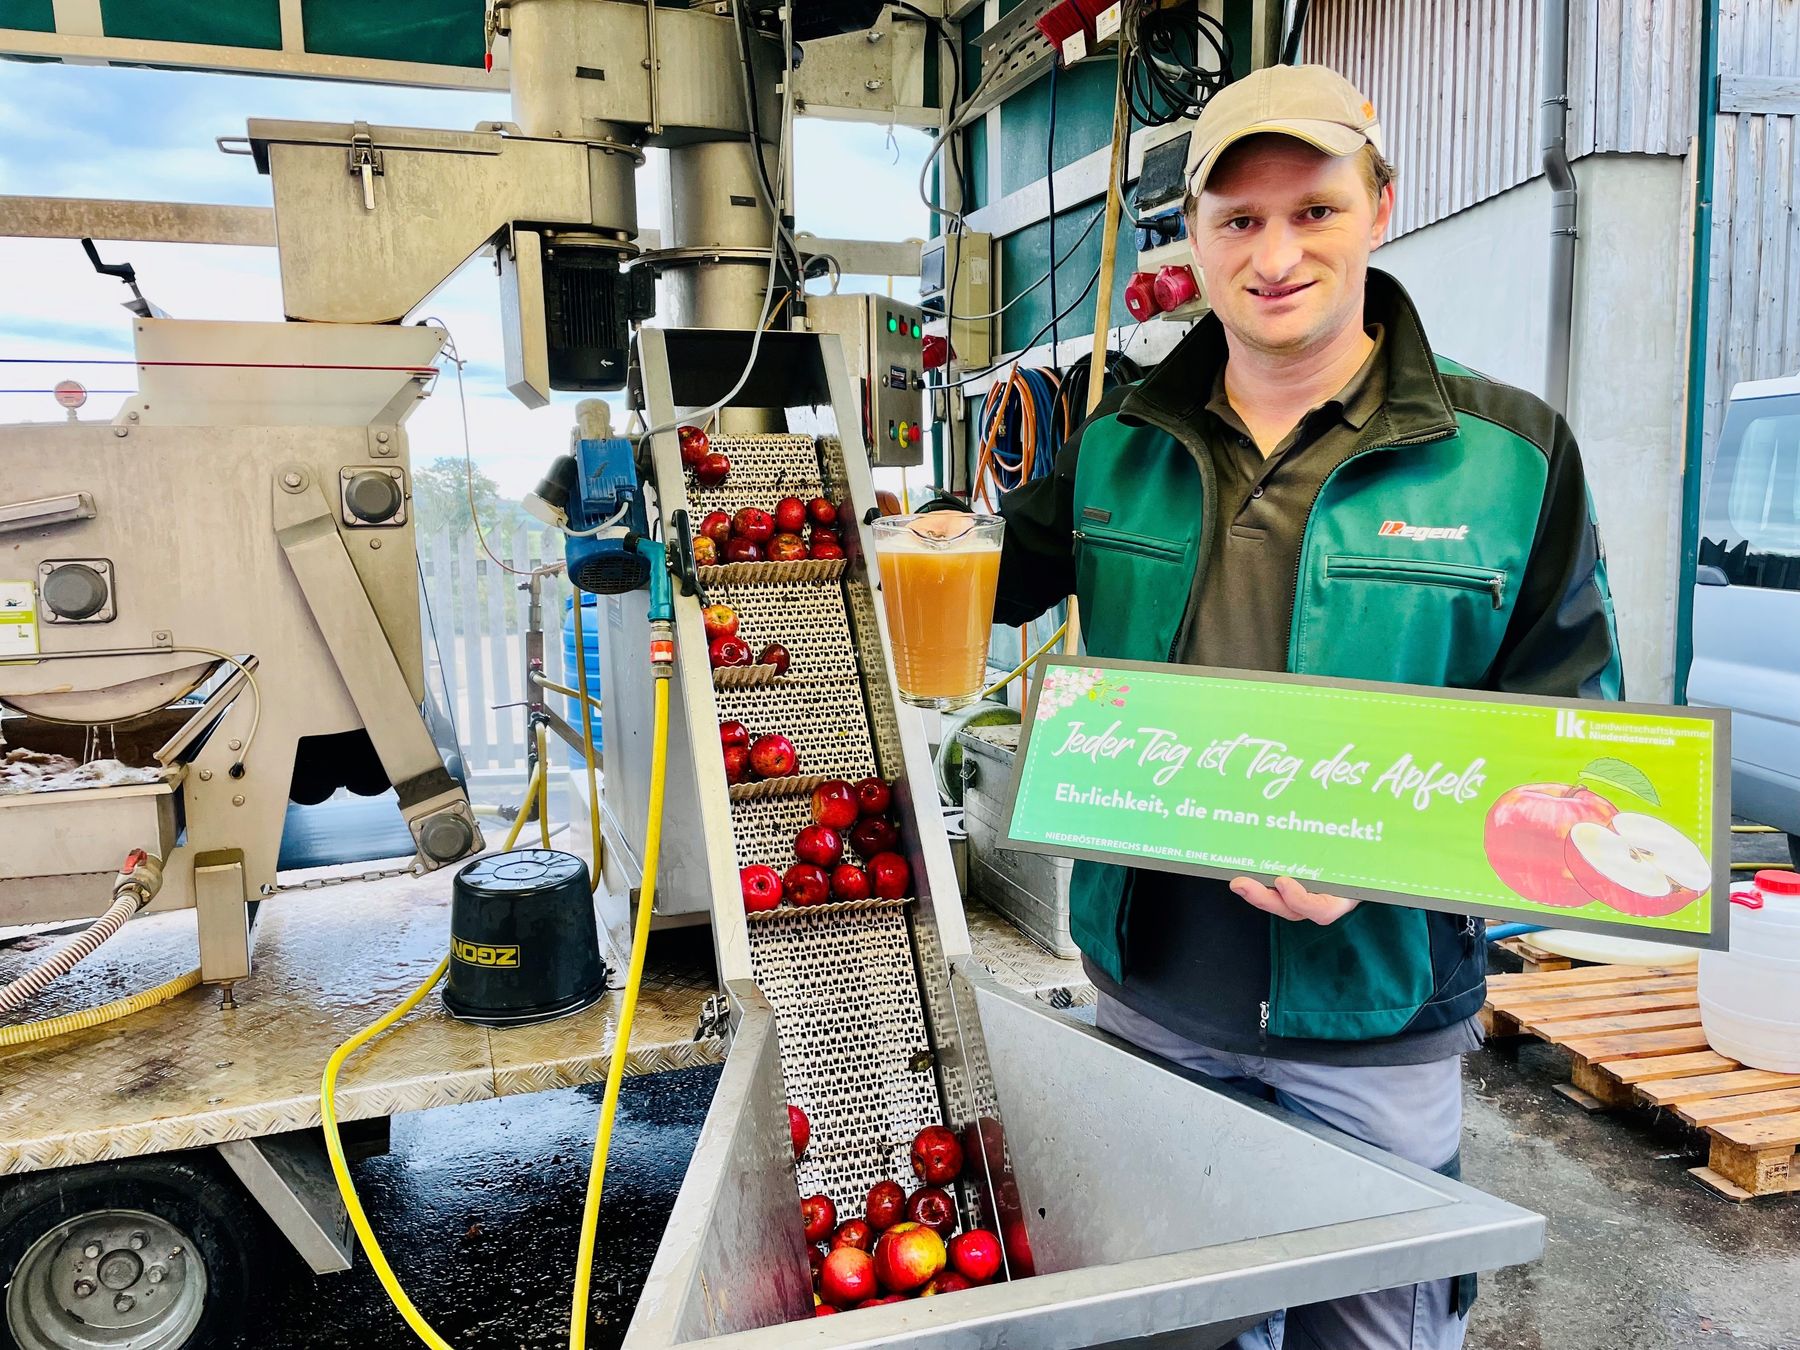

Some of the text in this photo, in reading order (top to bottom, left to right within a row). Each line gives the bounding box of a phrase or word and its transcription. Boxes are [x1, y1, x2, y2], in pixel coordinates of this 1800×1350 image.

[1378, 521, 1469, 541] Regent
[1555, 709, 1586, 739] lk
[1589, 731, 1675, 746] Niederösterreich
[1590, 721, 1710, 738] Landwirtschaftskammer
[1052, 720, 1487, 811] Jeder Tag ist Tag des Apfels
[1055, 783, 1384, 841] Ehrlichkeit, die man schmeckt!
[1045, 831, 1142, 852] NIEDERÖSTERREICHS
[1142, 844, 1184, 857] BAUERN.
[1186, 849, 1208, 861] EINE
[1210, 853, 1257, 867] KAMMER.
[452, 937, 517, 965] ZGON
